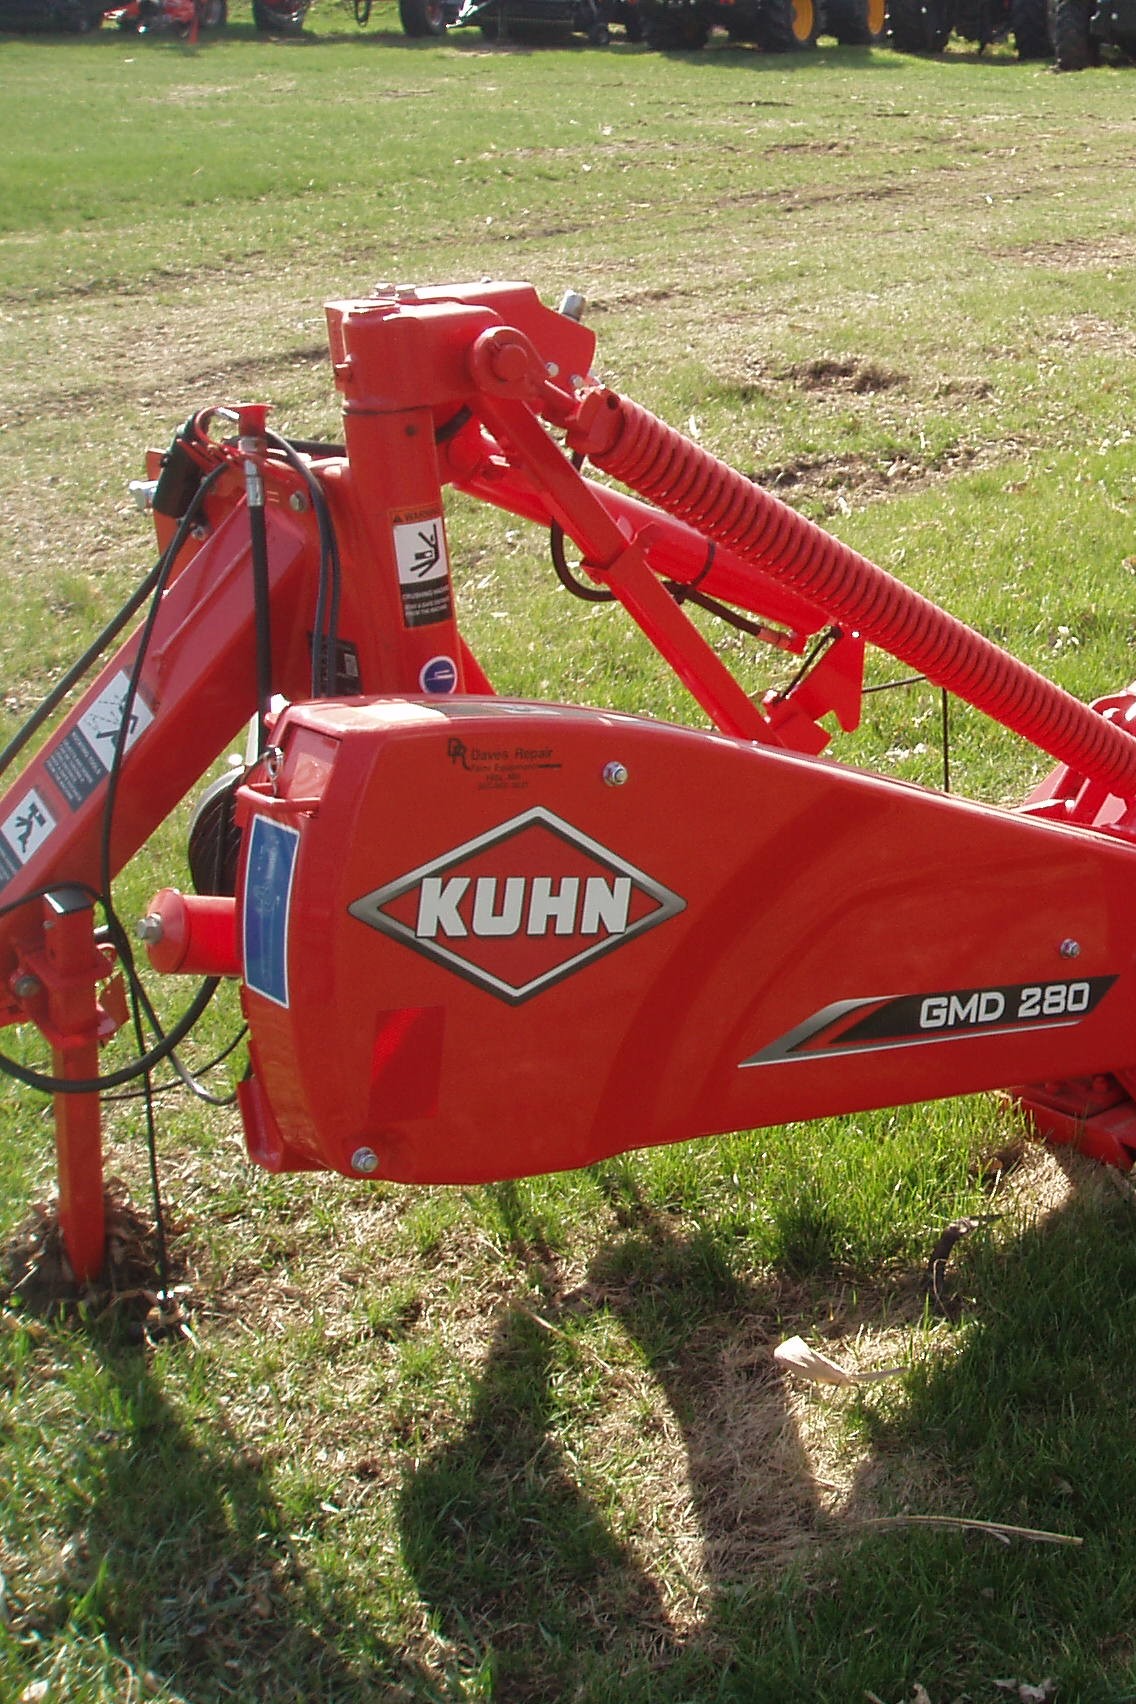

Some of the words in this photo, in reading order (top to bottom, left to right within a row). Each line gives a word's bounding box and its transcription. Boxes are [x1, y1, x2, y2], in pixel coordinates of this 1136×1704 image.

[471, 747, 509, 761] Daves
[515, 746, 553, 761] Repair
[415, 877, 632, 938] KUHN
[919, 991, 1006, 1029] GMD
[1017, 981, 1091, 1018] 280
